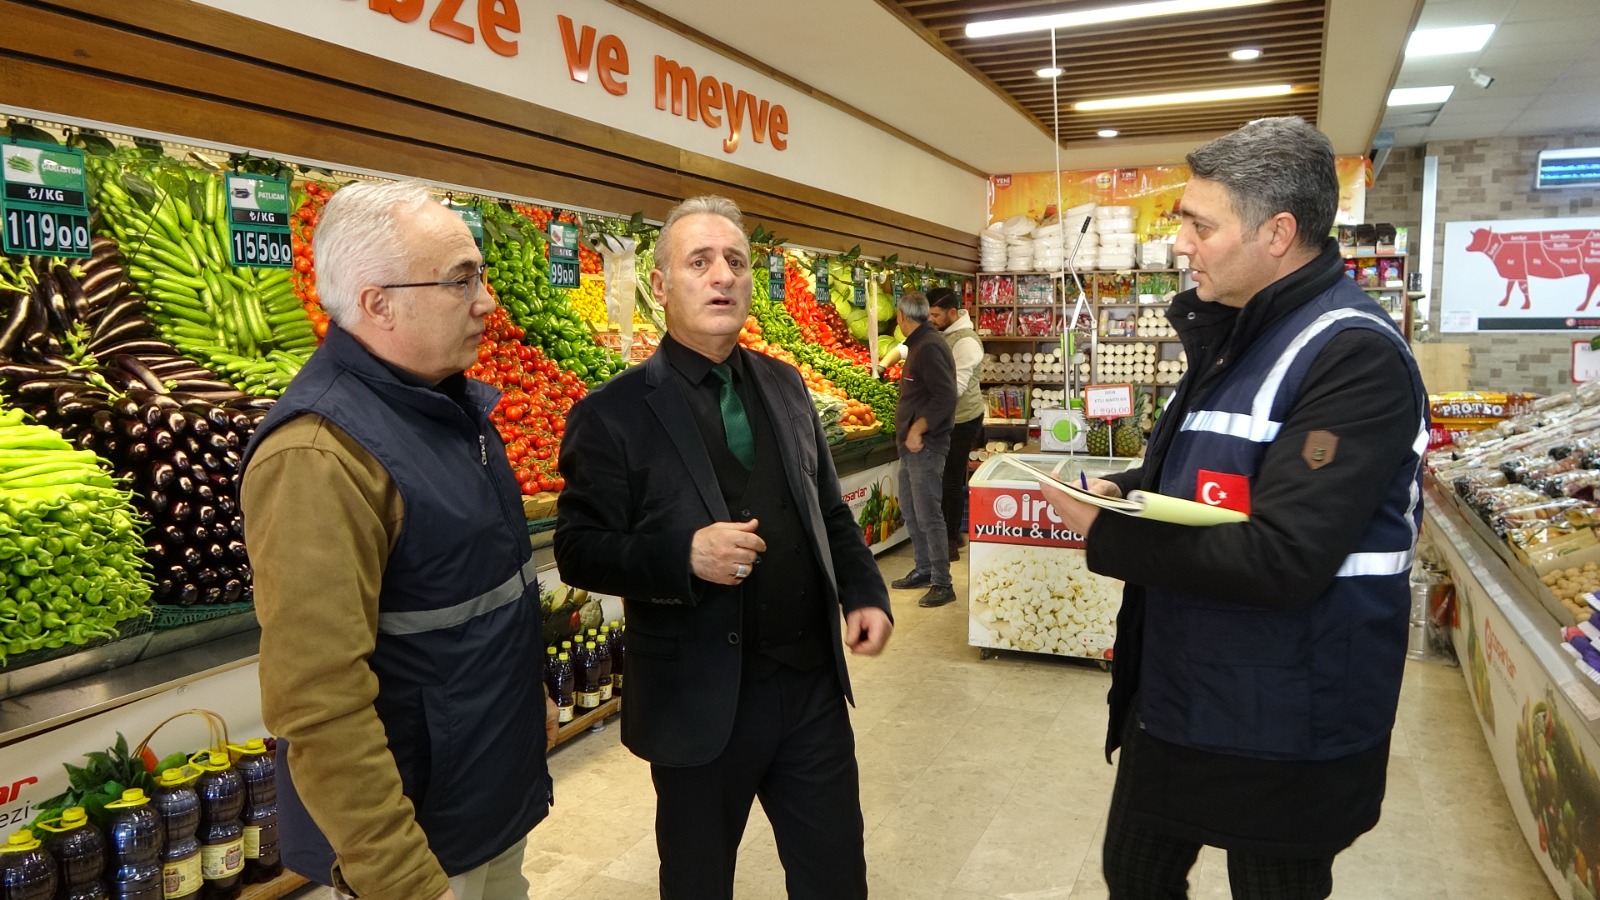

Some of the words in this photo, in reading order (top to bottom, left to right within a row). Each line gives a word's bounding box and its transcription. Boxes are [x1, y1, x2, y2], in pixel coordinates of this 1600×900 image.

[556, 14, 629, 96] ve
[655, 54, 789, 153] meyve
[975, 521, 1023, 539] yufka
[1030, 522, 1044, 539] &
